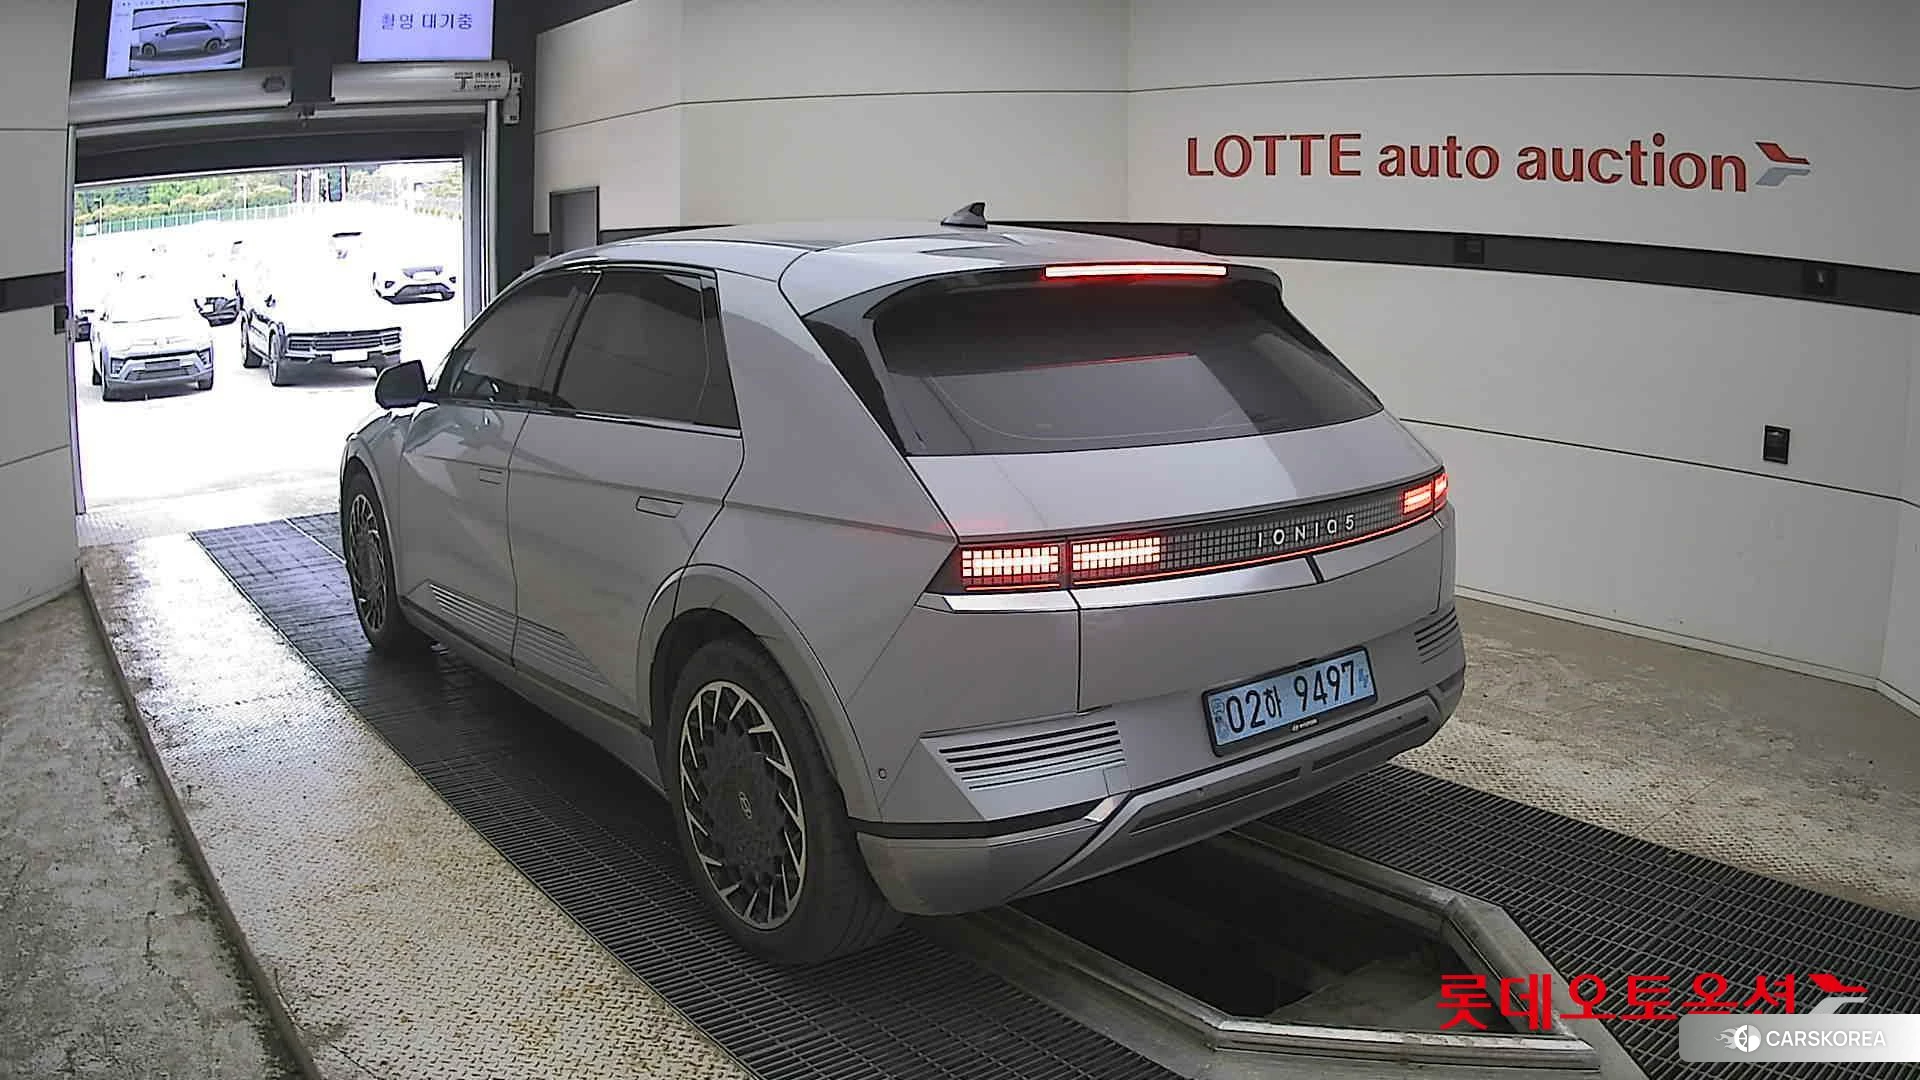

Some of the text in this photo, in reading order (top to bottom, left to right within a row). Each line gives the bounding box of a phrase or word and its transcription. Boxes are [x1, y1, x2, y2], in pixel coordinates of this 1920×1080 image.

[422, 13, 472, 30] 대기중
[1187, 132, 1748, 193] LOTTE auto auction
[1226, 660, 1355, 733] 02하 9497
